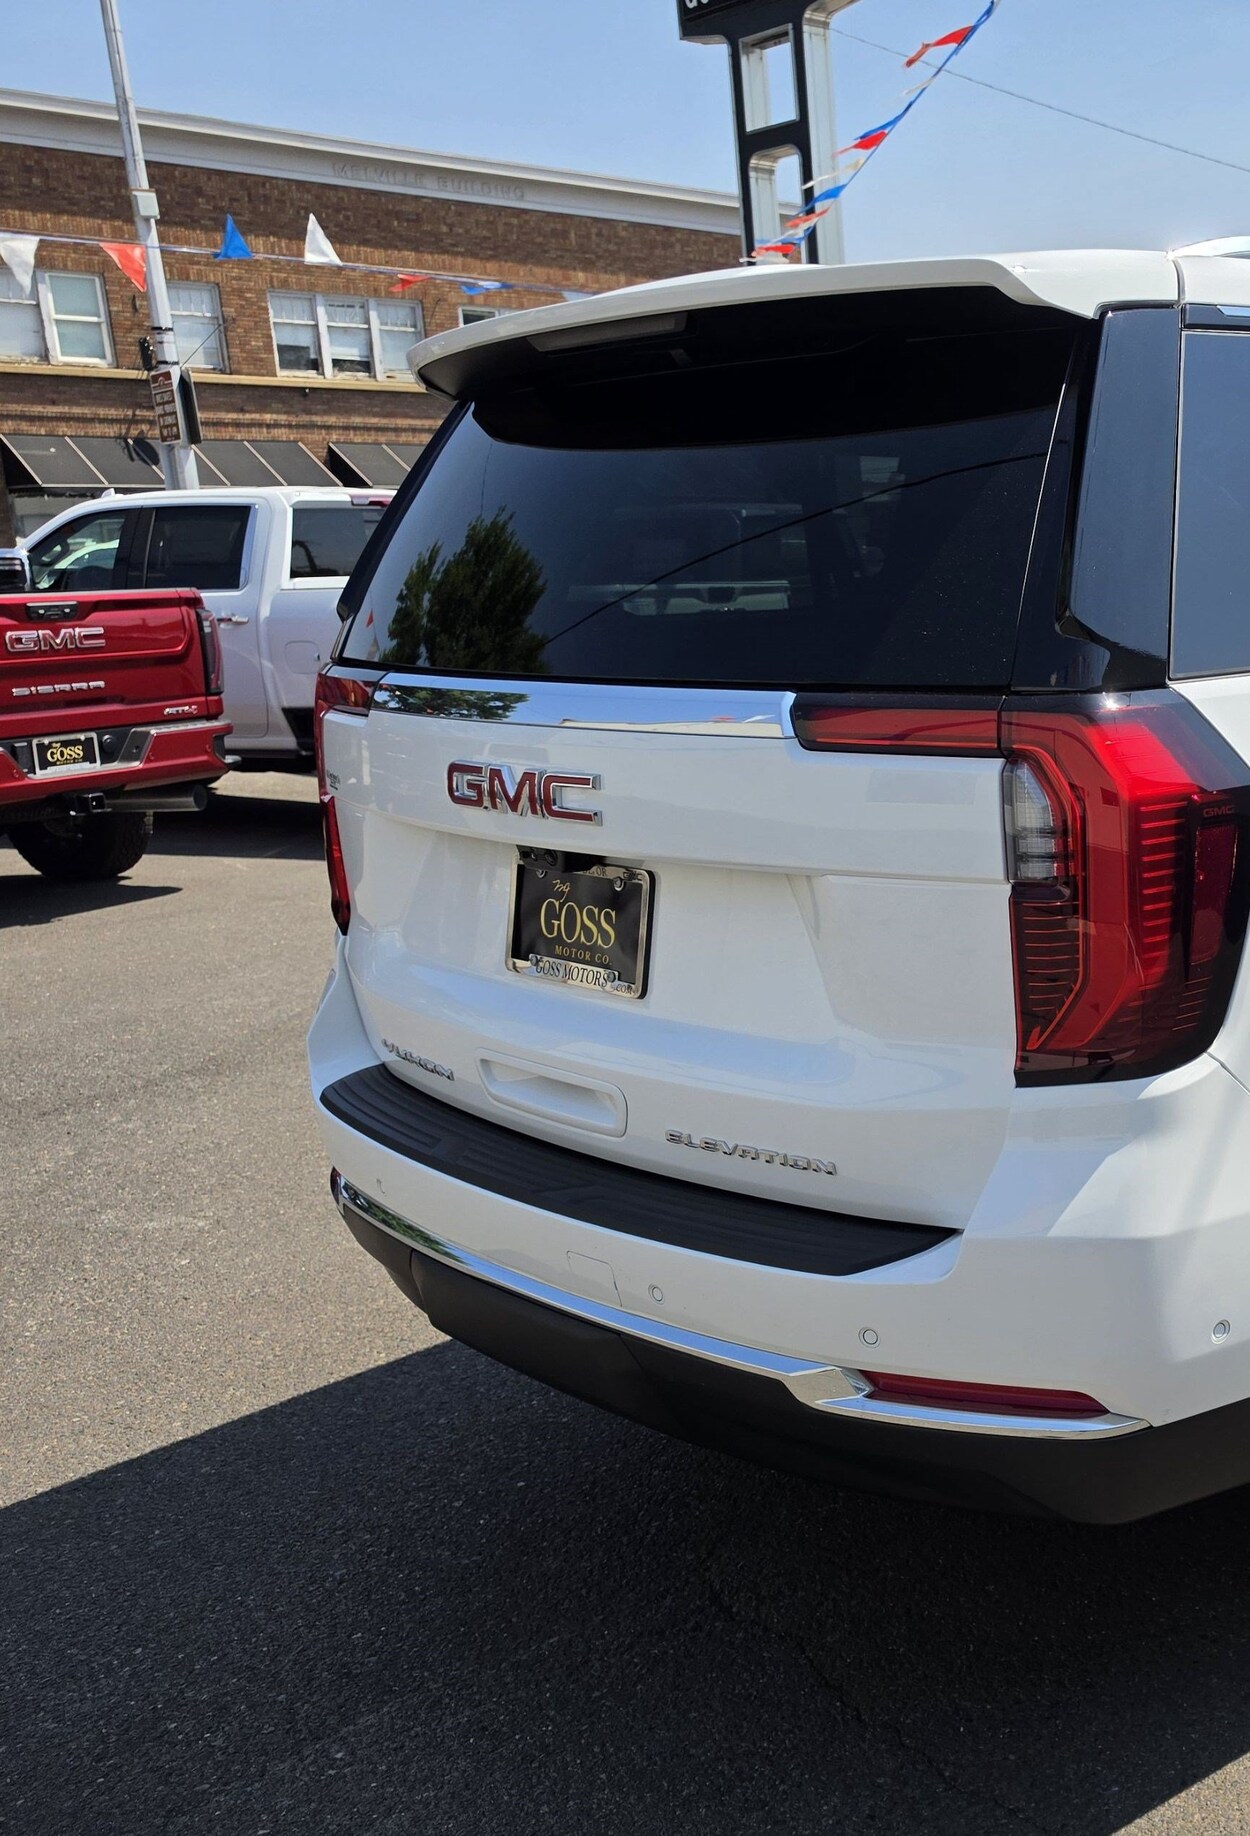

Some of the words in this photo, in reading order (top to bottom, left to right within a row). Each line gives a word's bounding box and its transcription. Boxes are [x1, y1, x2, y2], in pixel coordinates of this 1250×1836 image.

[437, 175, 525, 201] BUILDING
[5, 626, 106, 652] GMC
[12, 680, 105, 696] SIERRA
[47, 745, 84, 763] GOSS
[447, 759, 603, 827] GMC
[1203, 804, 1236, 818] GMC
[540, 898, 616, 949] GOSS
[554, 945, 591, 963] MOTOR
[535, 957, 561, 979] GOSS
[562, 961, 608, 988] MOTORS
[381, 1038, 455, 1081] YUKON
[665, 1129, 838, 1176] ELEVATION
